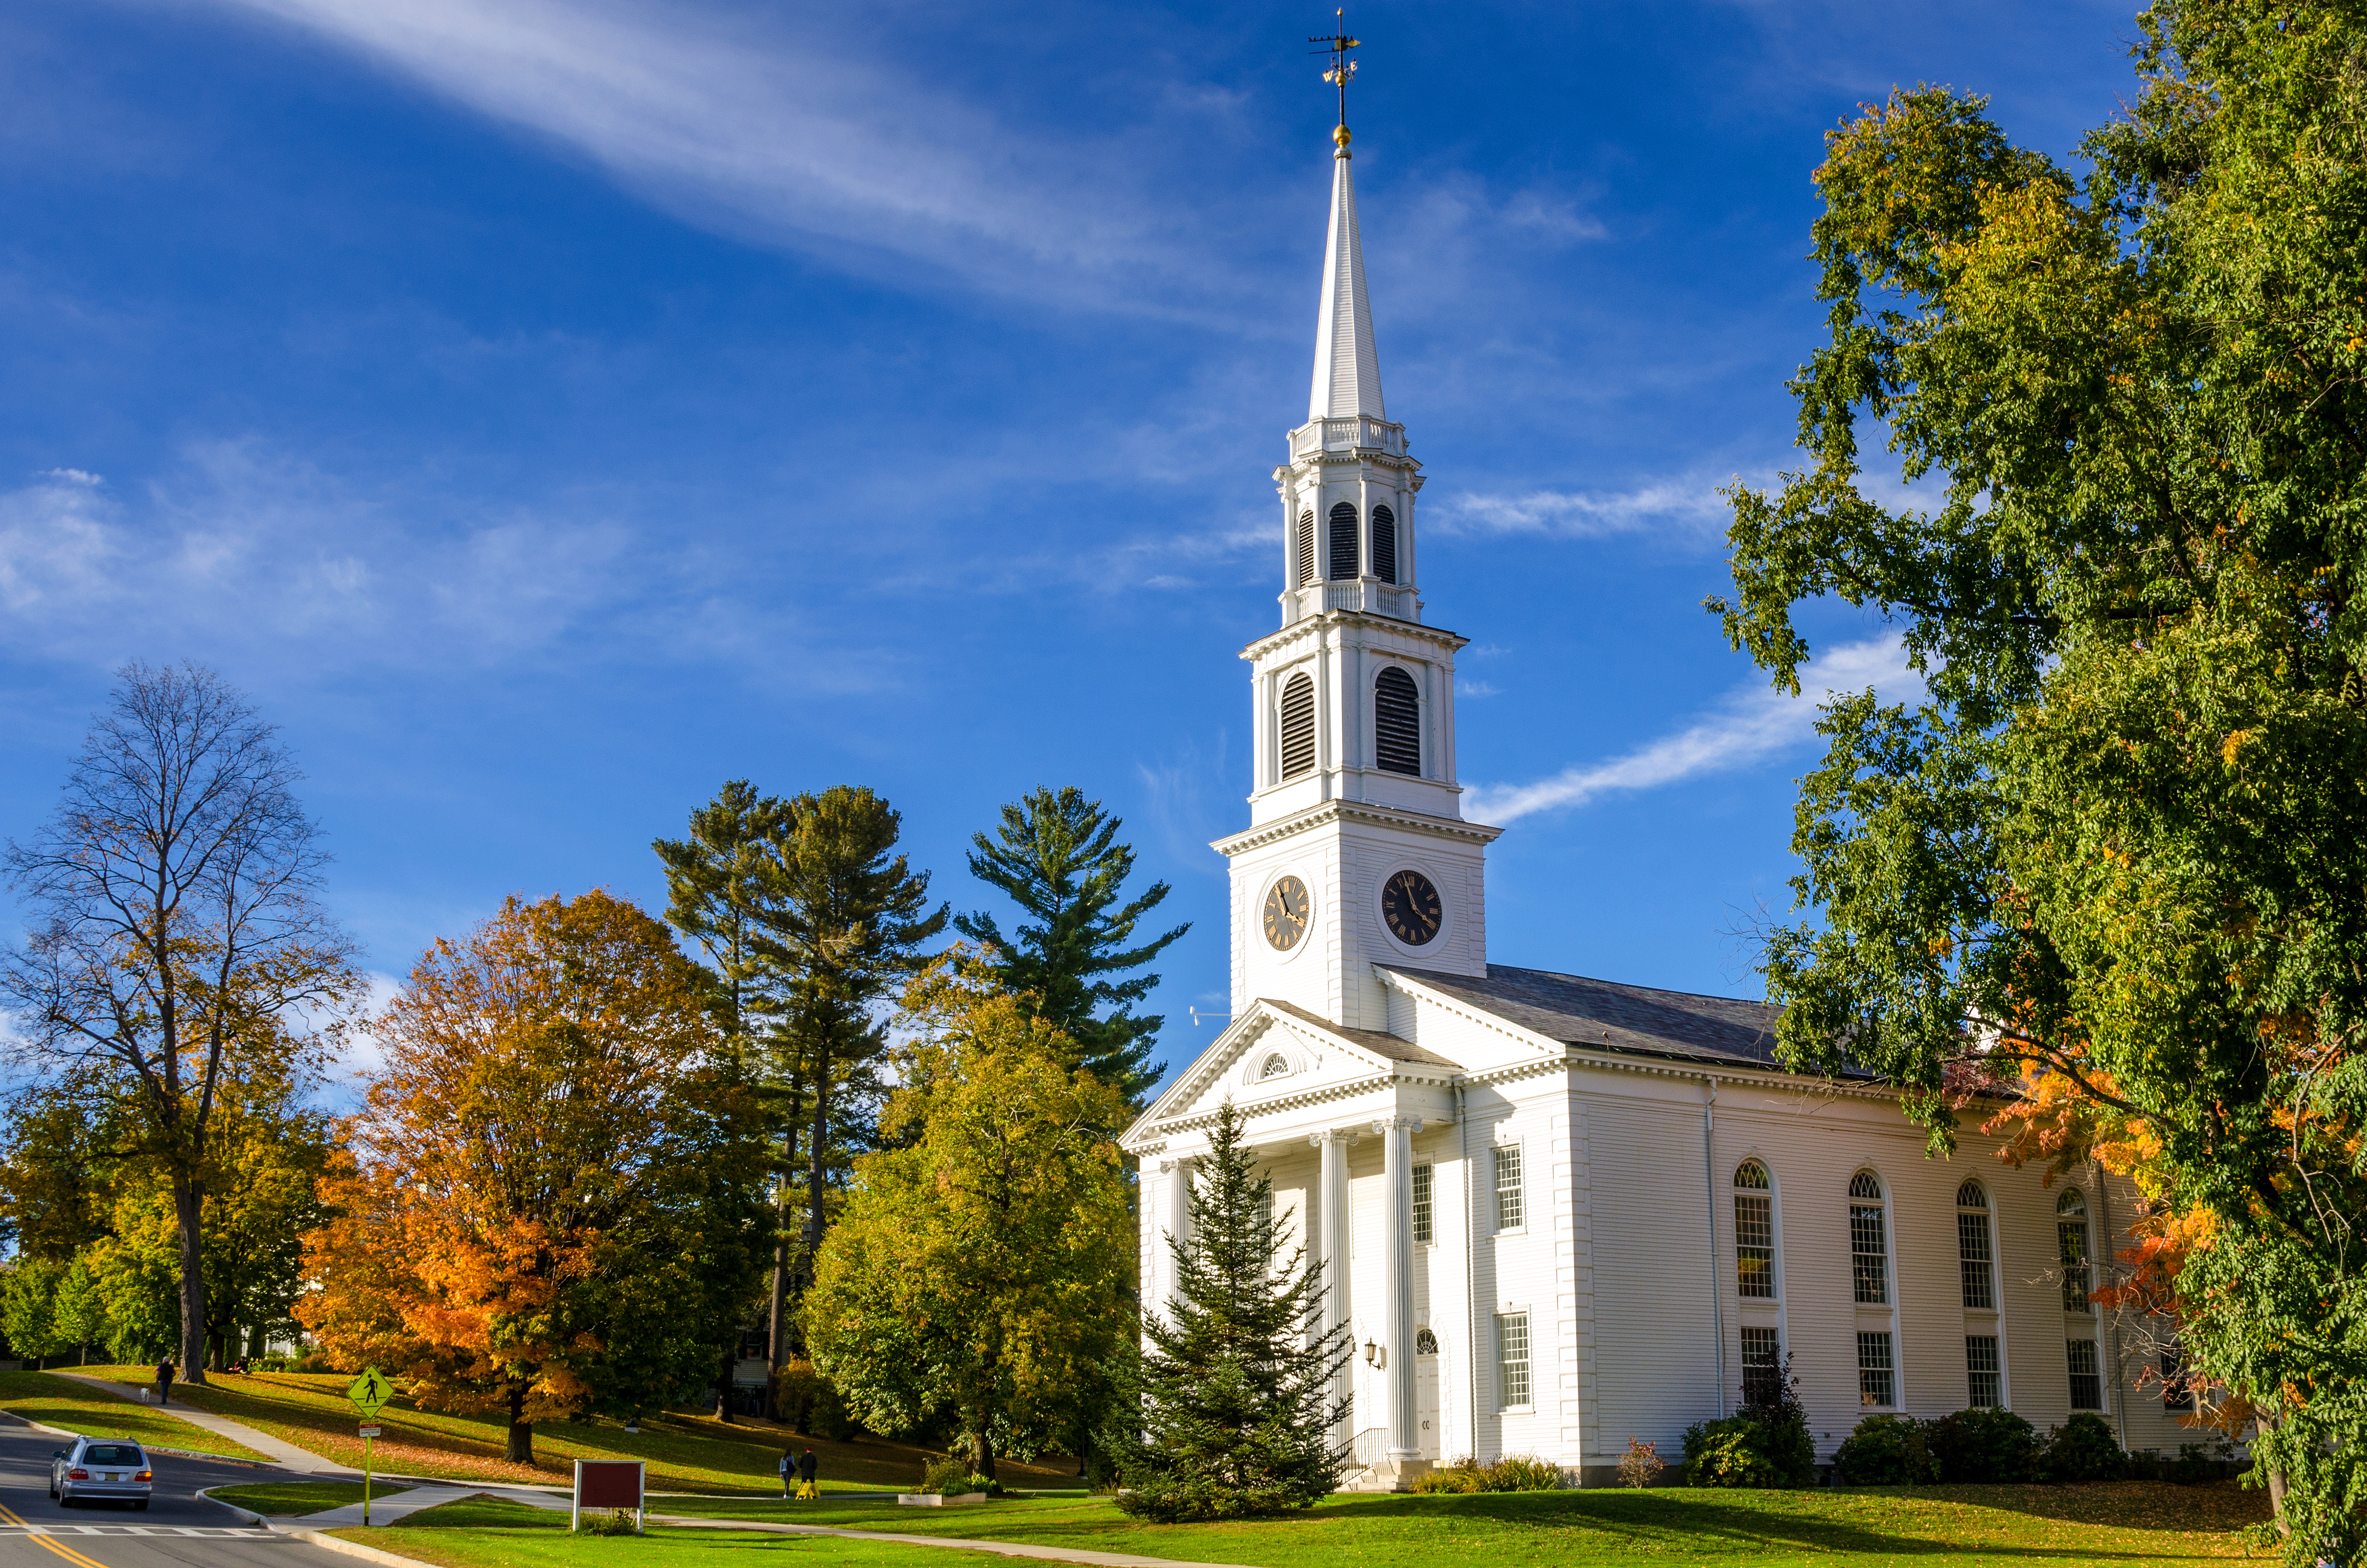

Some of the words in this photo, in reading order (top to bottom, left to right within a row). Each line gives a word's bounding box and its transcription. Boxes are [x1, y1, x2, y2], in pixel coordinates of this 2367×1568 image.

[1350, 61, 1358, 71] E
[1323, 71, 1334, 83] W
[1293, 882, 1297, 893] I
[1420, 882, 1425, 891] I
[1297, 891, 1304, 901] II
[1389, 888, 1397, 896] X
[1267, 914, 1274, 923] IX
[1293, 930, 1298, 939] V
[1421, 928, 1428, 938] V
